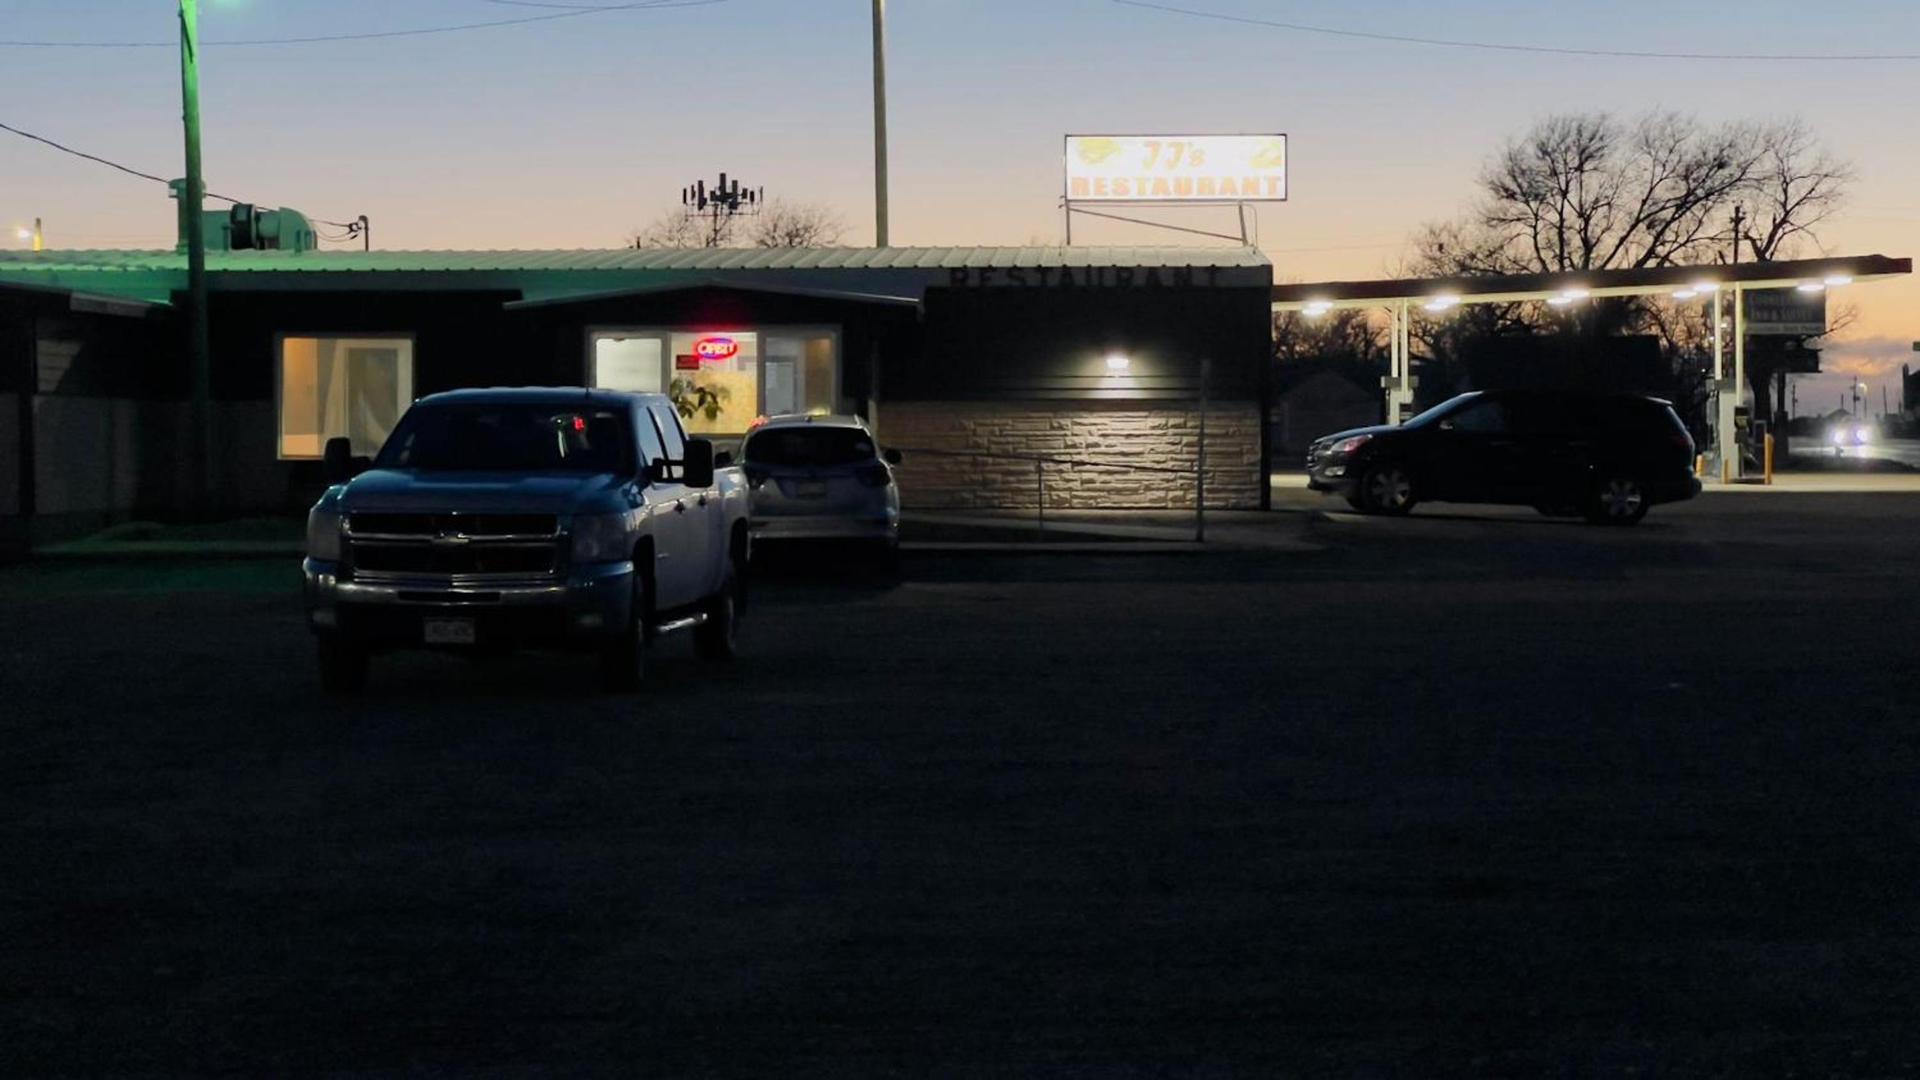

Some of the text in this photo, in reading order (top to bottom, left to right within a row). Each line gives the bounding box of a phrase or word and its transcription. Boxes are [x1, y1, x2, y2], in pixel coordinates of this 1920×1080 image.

[1070, 176, 1282, 197] RESTAURANT
[950, 267, 1220, 287] RESTAURANT
[698, 342, 734, 355] OPEN
